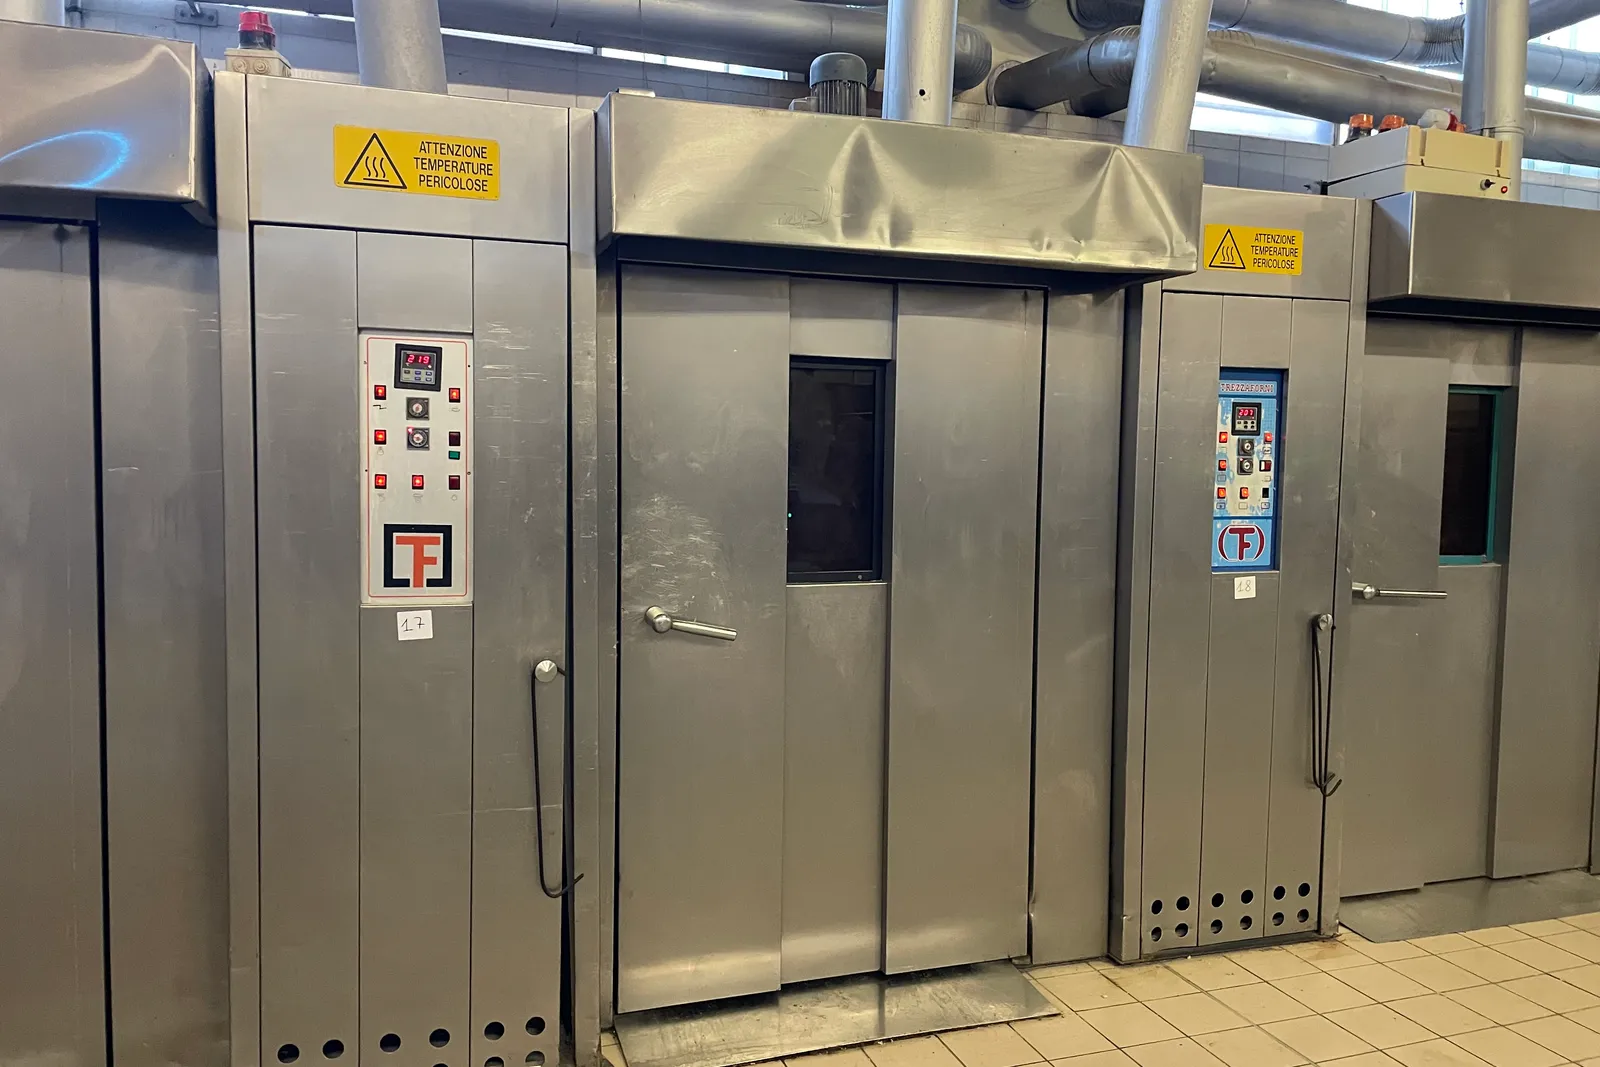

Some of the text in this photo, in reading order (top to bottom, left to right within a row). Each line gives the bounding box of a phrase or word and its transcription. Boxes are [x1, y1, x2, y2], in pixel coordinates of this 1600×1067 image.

[419, 141, 487, 159] ATTENZIONE
[413, 157, 493, 176] TEMPERATURE
[419, 174, 488, 192] PERICOLOSE
[1254, 233, 1296, 245] ATTENZIONE
[1250, 245, 1299, 257] TEMPERATURE
[1252, 257, 1295, 269] PERICOLOSE
[407, 354, 430, 364] 219
[1220, 383, 1274, 393] TREZZAFORNI
[1236, 579, 1252, 592] 18
[401, 616, 426, 632] 17
